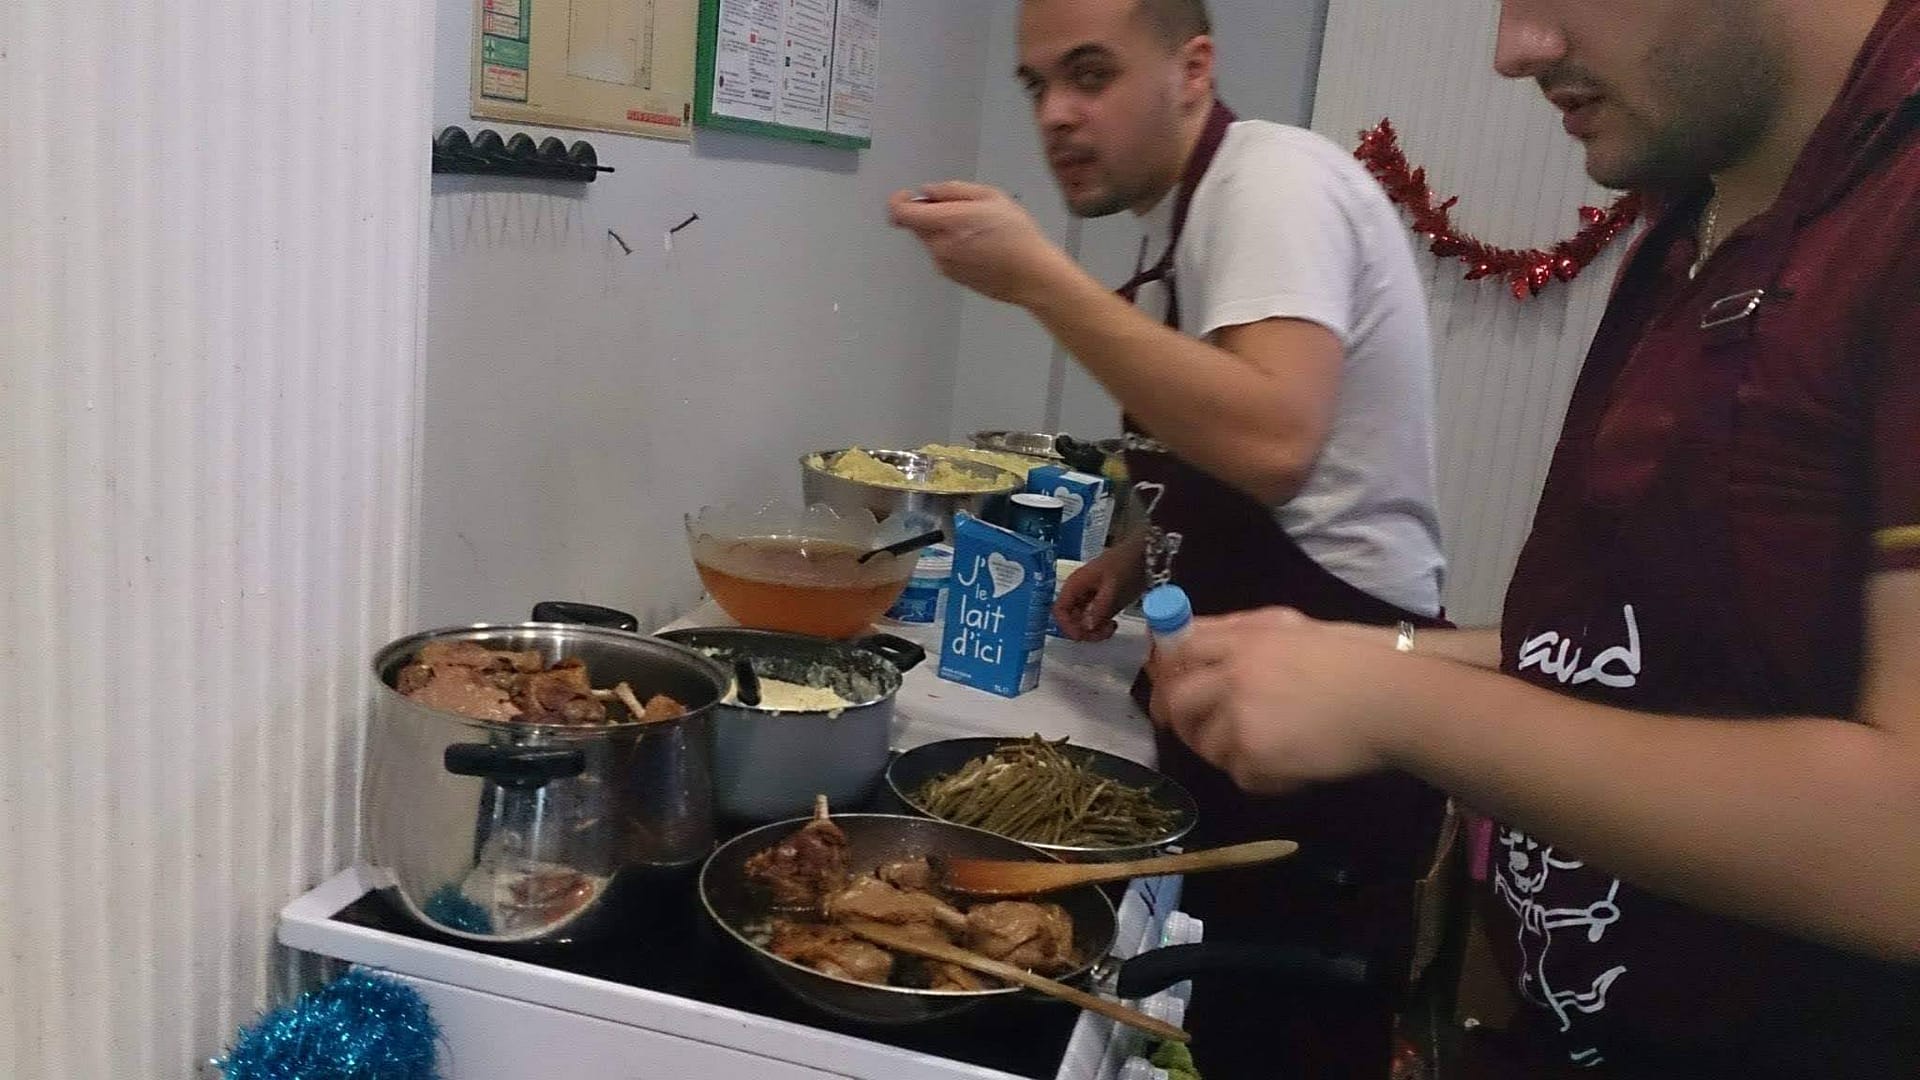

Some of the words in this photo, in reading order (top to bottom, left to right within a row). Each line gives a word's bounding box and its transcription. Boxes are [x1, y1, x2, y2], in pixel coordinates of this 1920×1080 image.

[975, 583, 988, 601] le
[959, 594, 1005, 633] lait
[952, 628, 1004, 665] d'ici
